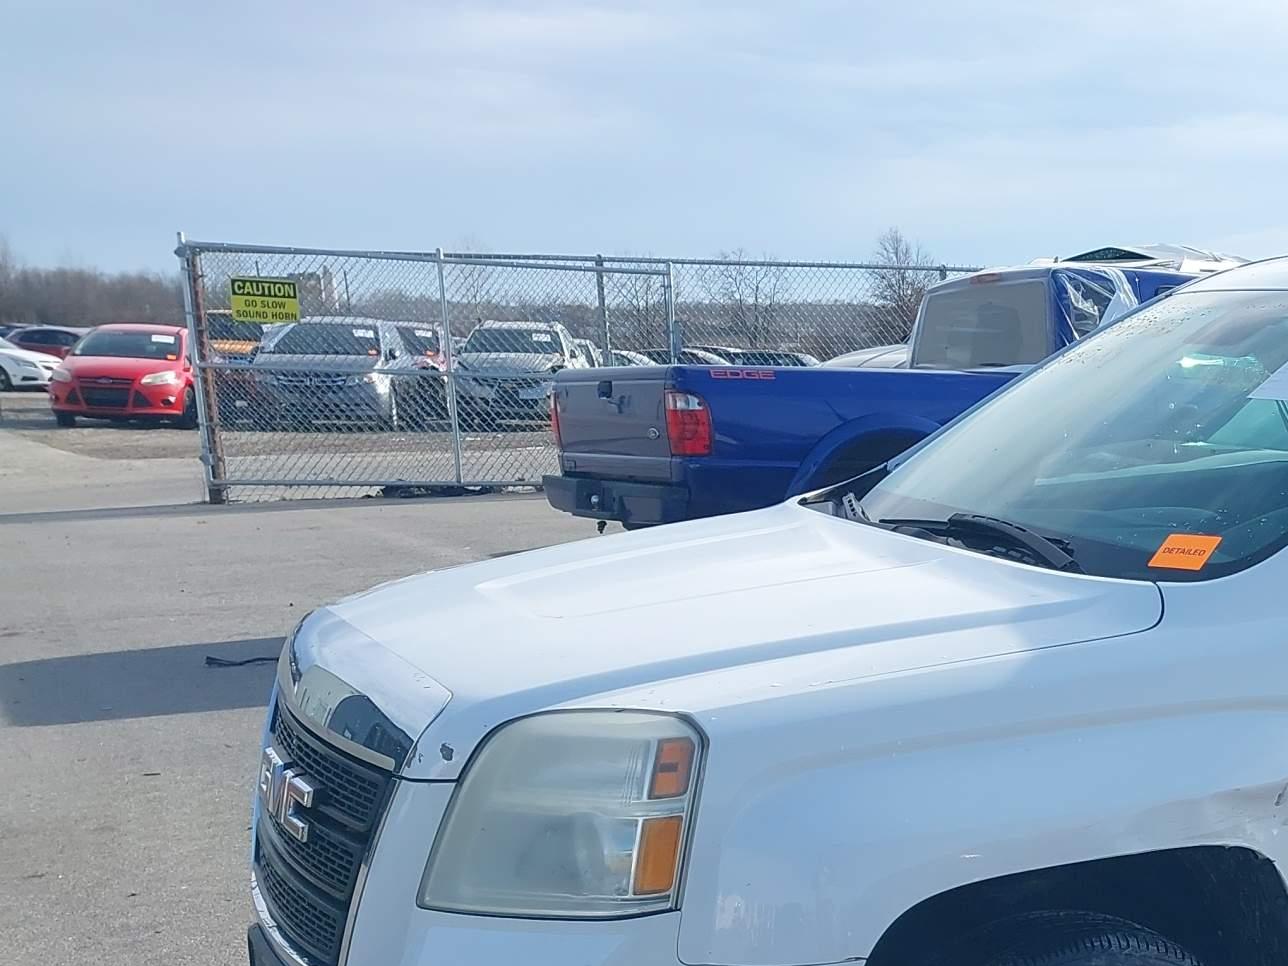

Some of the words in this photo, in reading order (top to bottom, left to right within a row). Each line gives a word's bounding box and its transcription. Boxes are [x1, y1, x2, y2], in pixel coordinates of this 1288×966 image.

[234, 281, 295, 297] CAUTION
[244, 299, 258, 308] GO
[260, 300, 287, 310] SLOW
[235, 309, 268, 320] SOUND
[271, 311, 297, 321] HORN
[708, 369, 777, 381] EDGE
[1161, 546, 1207, 557] DETAILED
[259, 746, 314, 843] GMC
